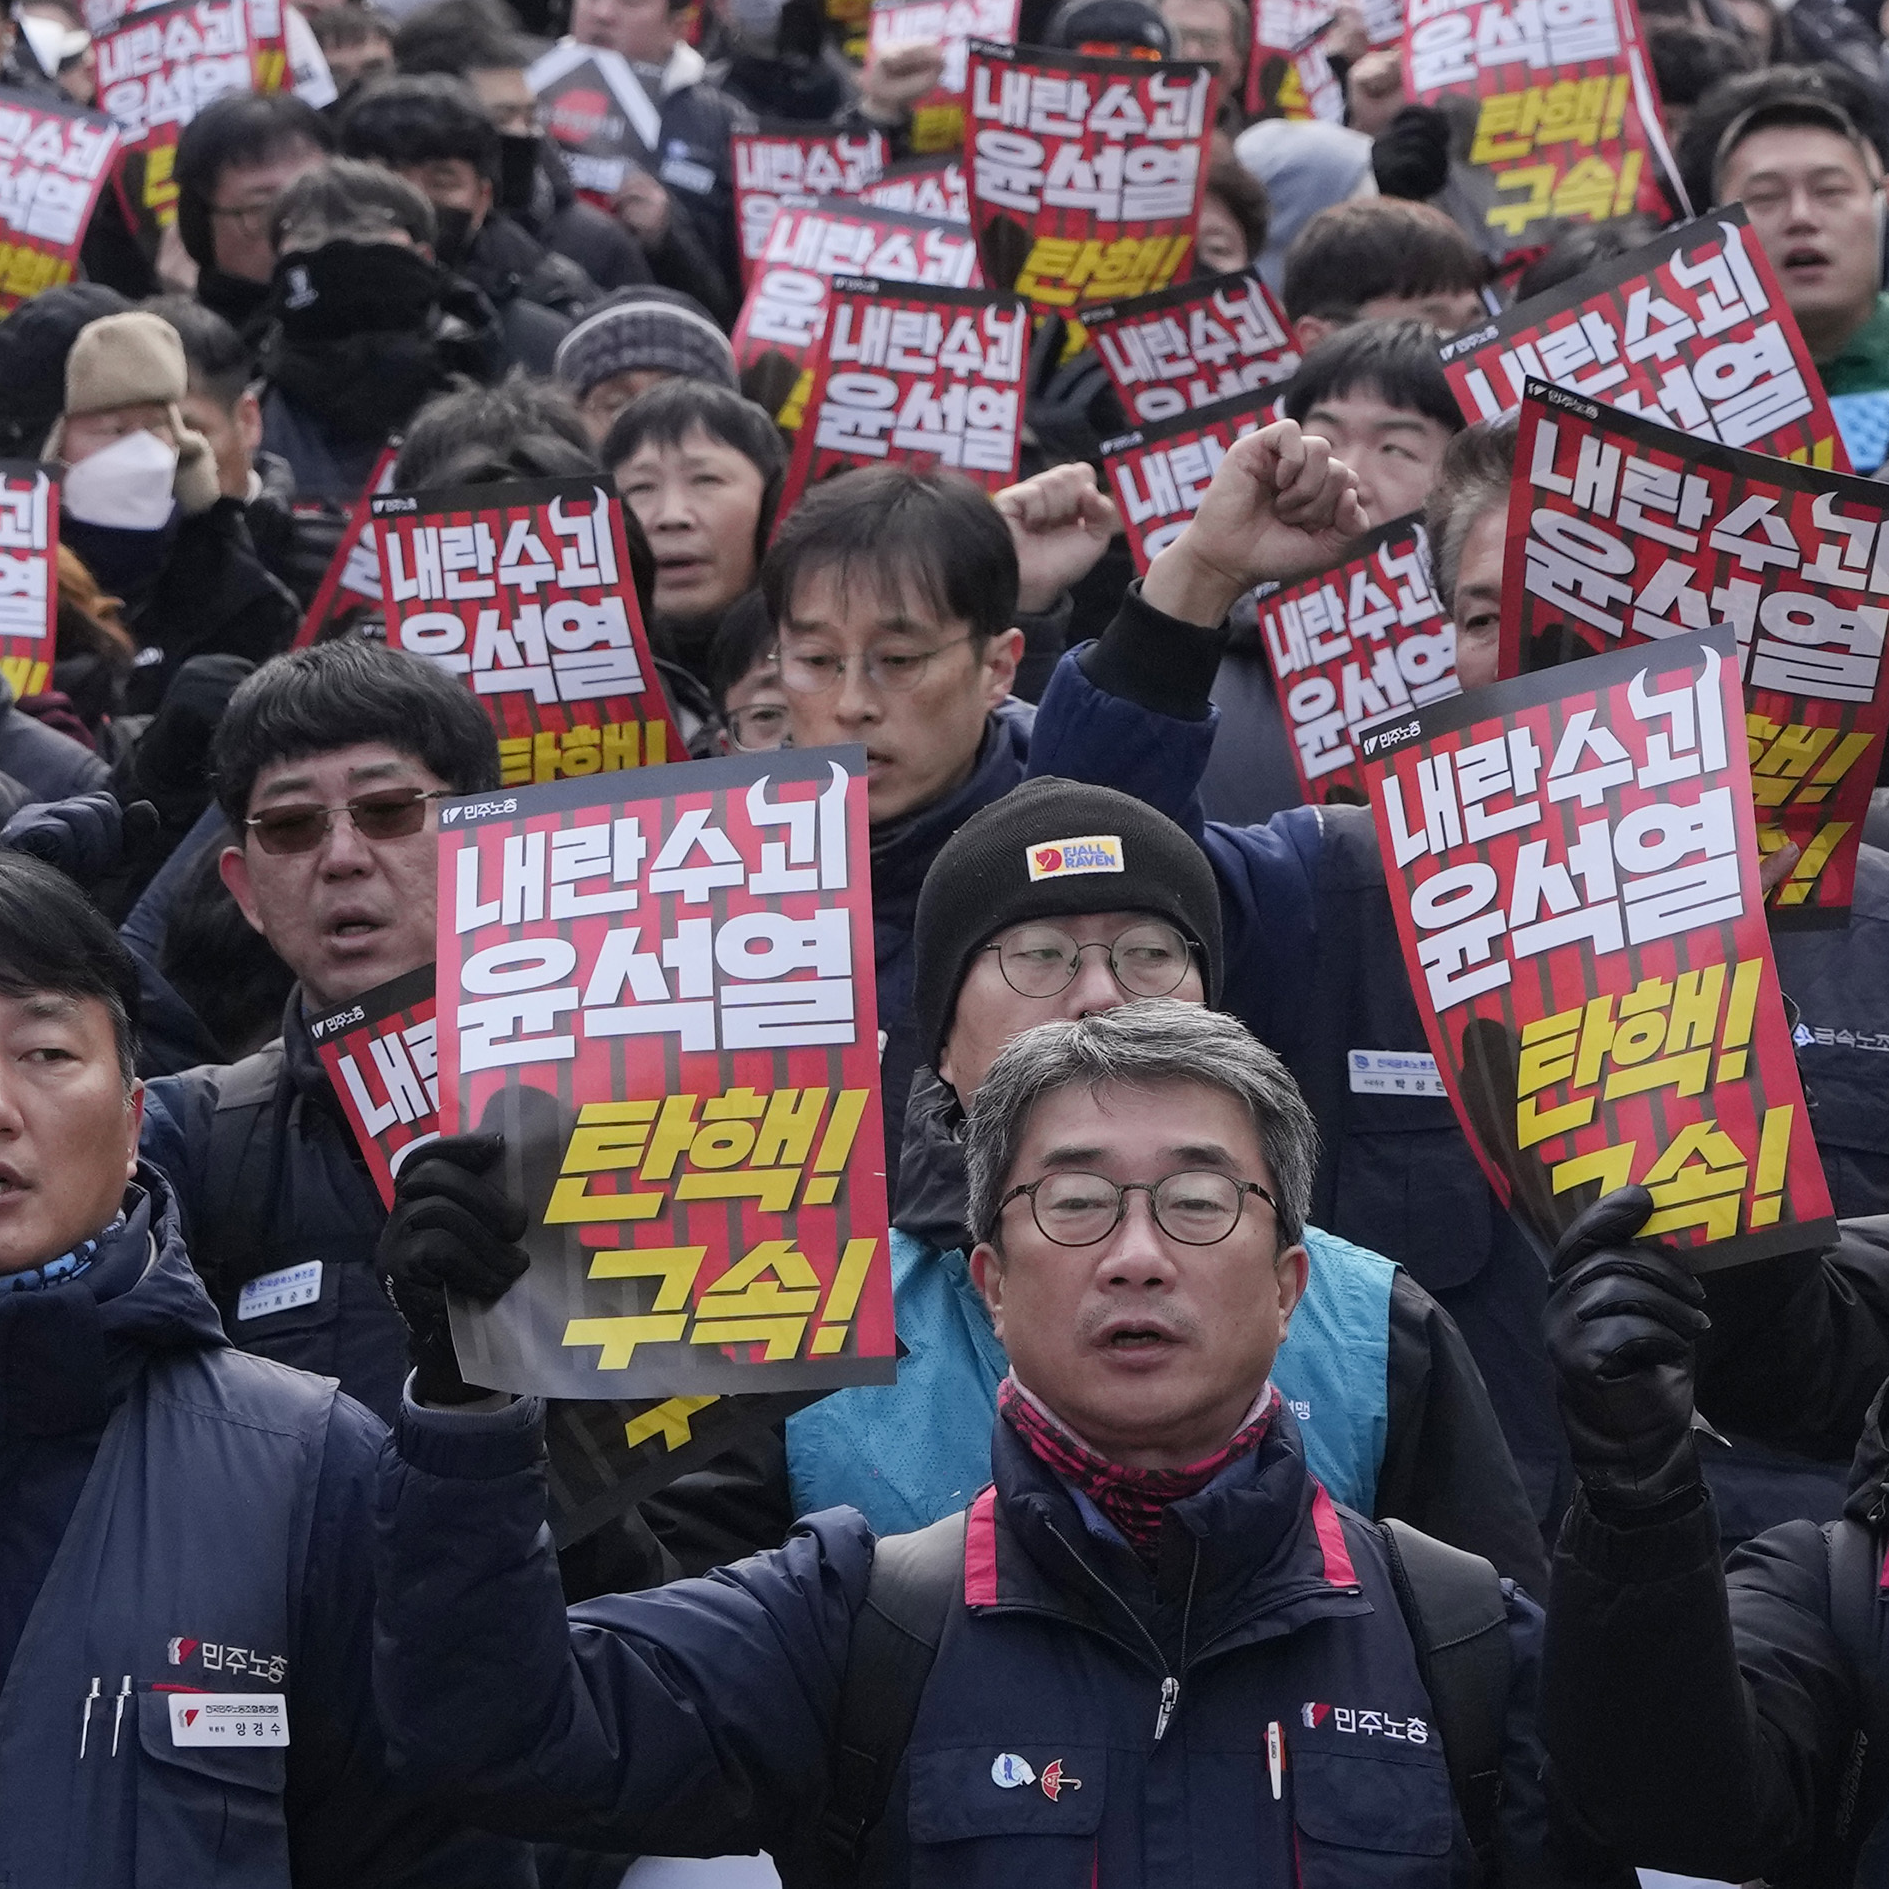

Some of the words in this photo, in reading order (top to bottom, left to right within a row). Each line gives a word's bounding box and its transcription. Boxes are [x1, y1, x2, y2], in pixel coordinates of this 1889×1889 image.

[973, 65, 1211, 141] 내란수괴
[1469, 72, 1632, 164] 탄핵!
[735, 131, 884, 194] 내란수괴
[973, 129, 1202, 222] 윤석열
[1485, 151, 1643, 234] 구속!
[769, 208, 978, 288] 내란수괴
[1014, 234, 1194, 307] 탄핵!
[829, 299, 1027, 383] 내란수괴
[1098, 275, 1287, 387] 내란수괴
[1465, 219, 1772, 423] 내란수괴
[814, 371, 1020, 474] 윤석열
[385, 485, 618, 602] 내란수괴
[398, 596, 648, 706] 윤석열
[1264, 522, 1443, 680] 내란수괴
[1381, 644, 1728, 868] 내란수괴
[456, 761, 849, 934] 내란수괴
[463, 798, 518, 822] 민주노총
[1065, 854, 1115, 868] RAVEN
[1410, 786, 1745, 1014] 윤석열
[457, 907, 855, 1074] 윤석열
[1517, 956, 1763, 1151] 탄핵!
[542, 1087, 870, 1225] 탄핵!
[561, 1238, 878, 1371] 구속!
[201, 1641, 289, 1685] 민주노총
[1334, 1706, 1428, 1745] 민주노총
